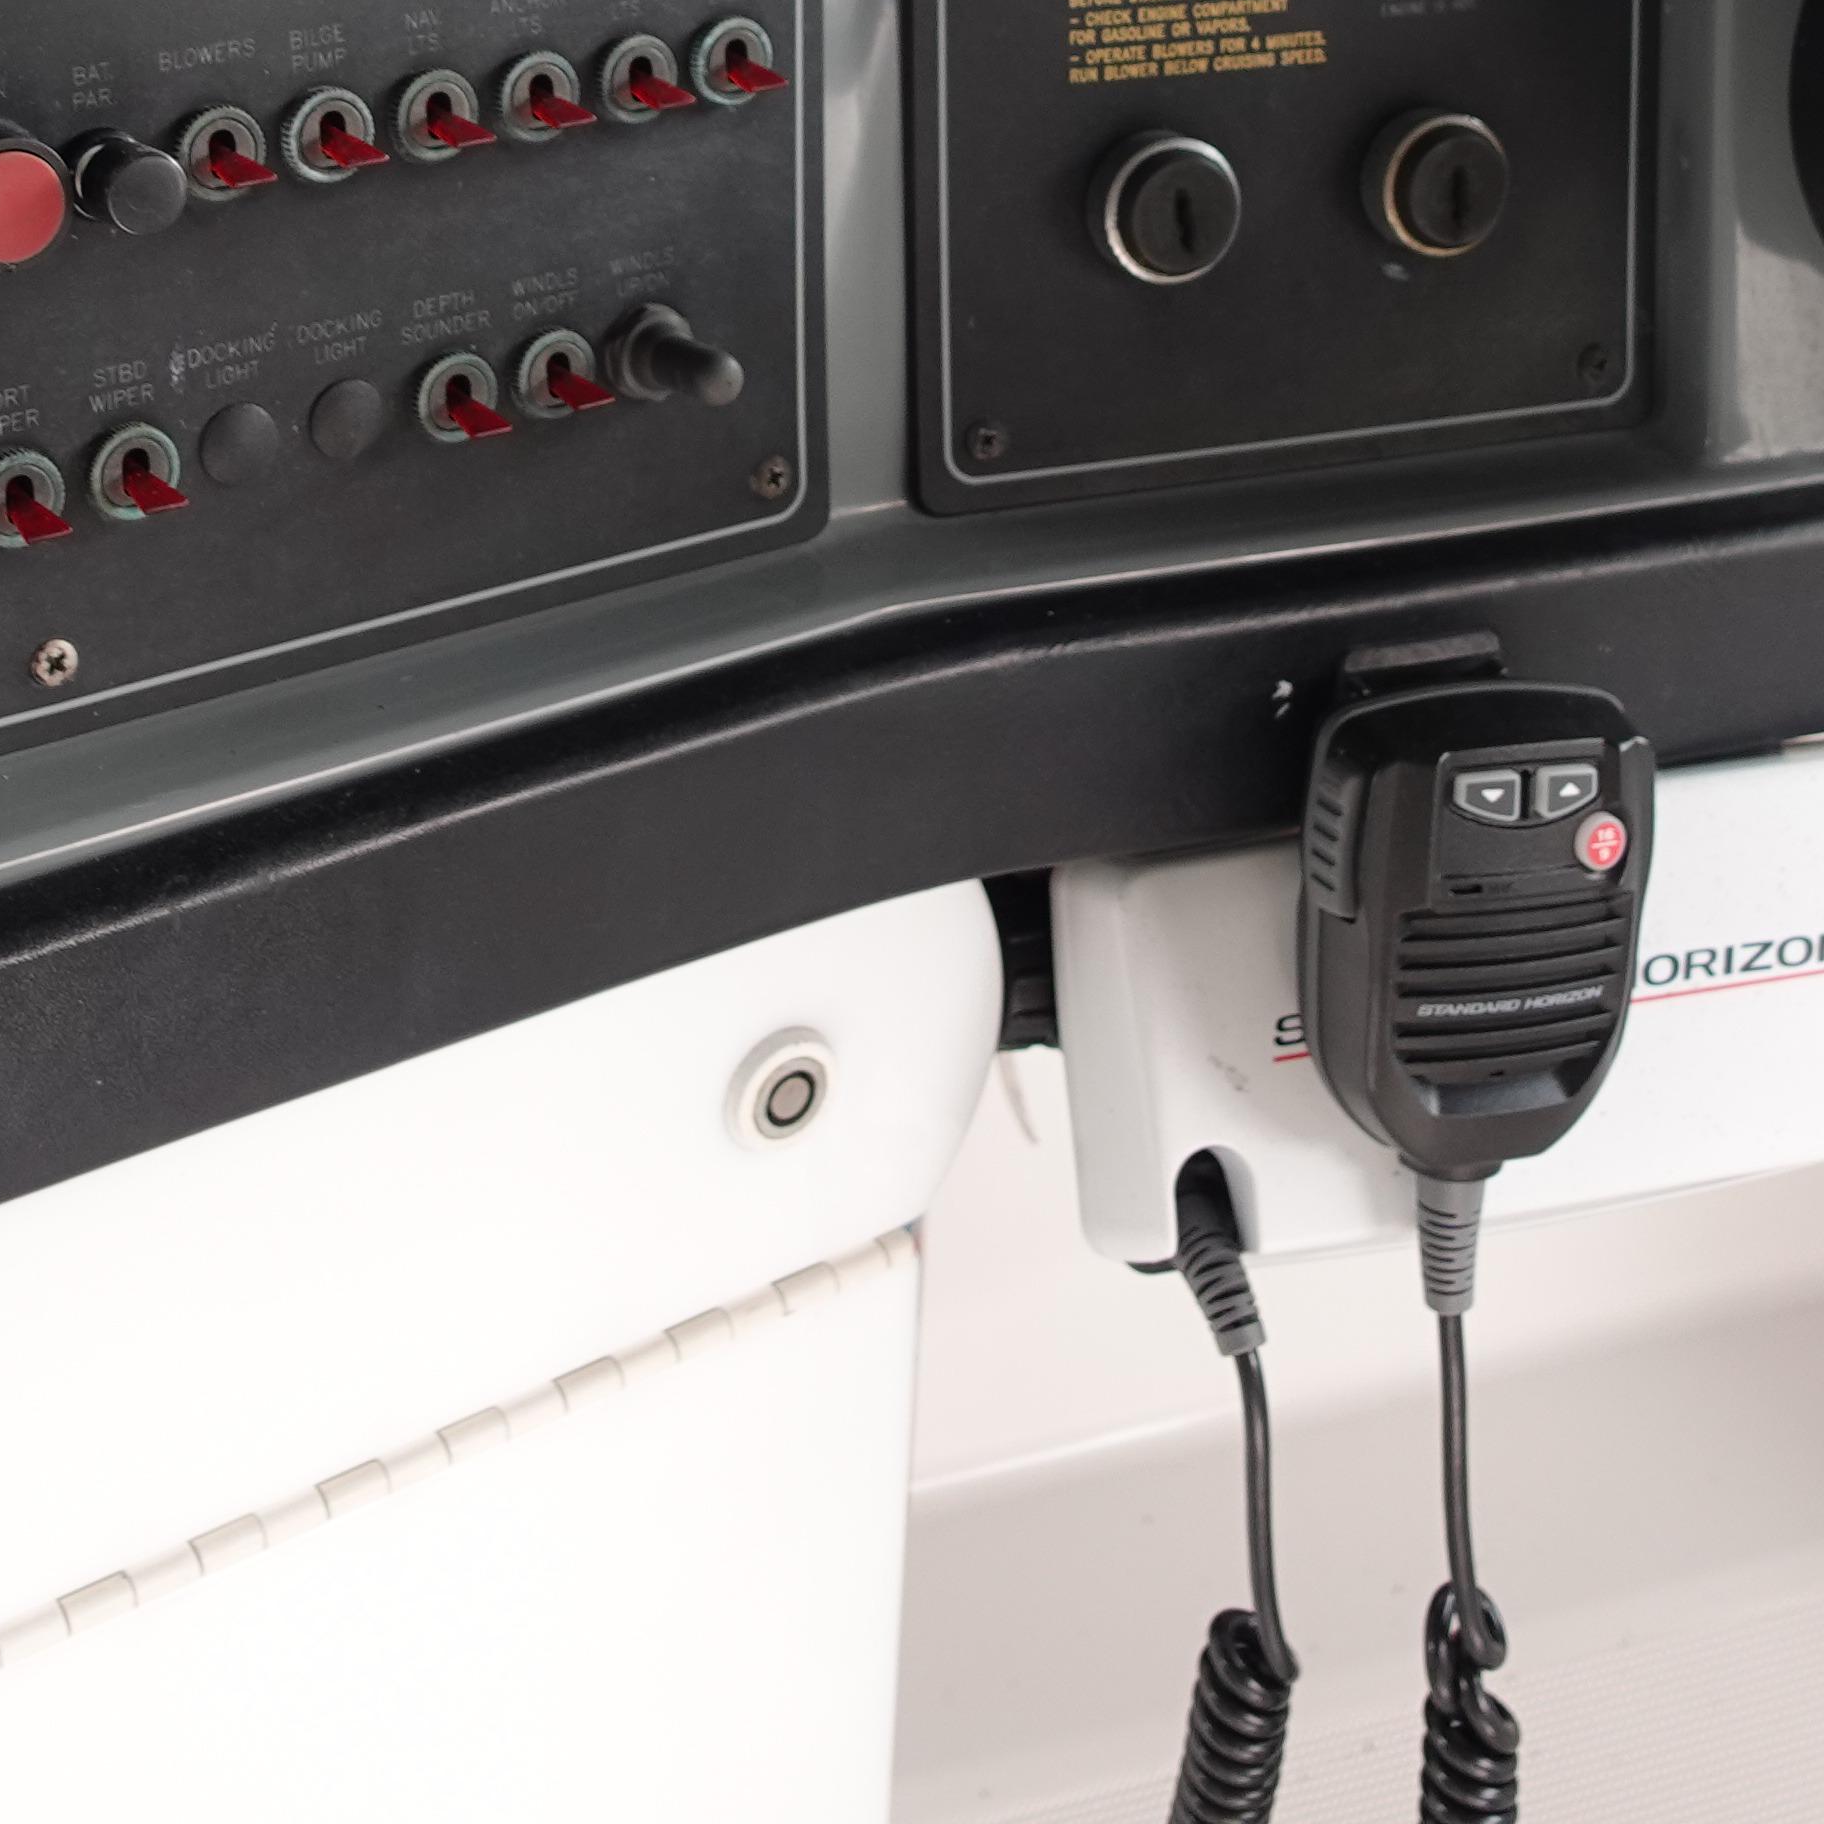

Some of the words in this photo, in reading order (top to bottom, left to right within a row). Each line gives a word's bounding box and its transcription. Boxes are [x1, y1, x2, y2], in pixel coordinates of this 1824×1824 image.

[1084, 9, 1133, 28] CHECK
[1136, 3, 1189, 24] ENGINE
[289, 23, 347, 51] BILGE
[1068, 29, 1097, 46] FOR
[1100, 24, 1167, 44] GASOLINE
[1170, 20, 1192, 38] OR
[158, 36, 257, 72] BLOWERS
[290, 48, 348, 74] PUMP
[1085, 45, 1147, 65] OPERATE
[1219, 37, 1247, 55] FOR
[1068, 67, 1099, 85] RUN
[1103, 62, 1159, 82] BLOWER
[1163, 57, 1209, 77] BELOW
[412, 290, 476, 319] DEPTH
[295, 309, 383, 345] DOCKING
[401, 309, 490, 346] SOUNDER
[186, 333, 276, 370] DOCKING
[314, 336, 368, 366] LIGHT
[93, 360, 148, 388] STBD
[205, 359, 260, 391] LIGHT
[88, 382, 156, 414] WIPER
[1417, 998, 1522, 1018] STANDARD
[1524, 984, 1604, 1011] HORIZON
